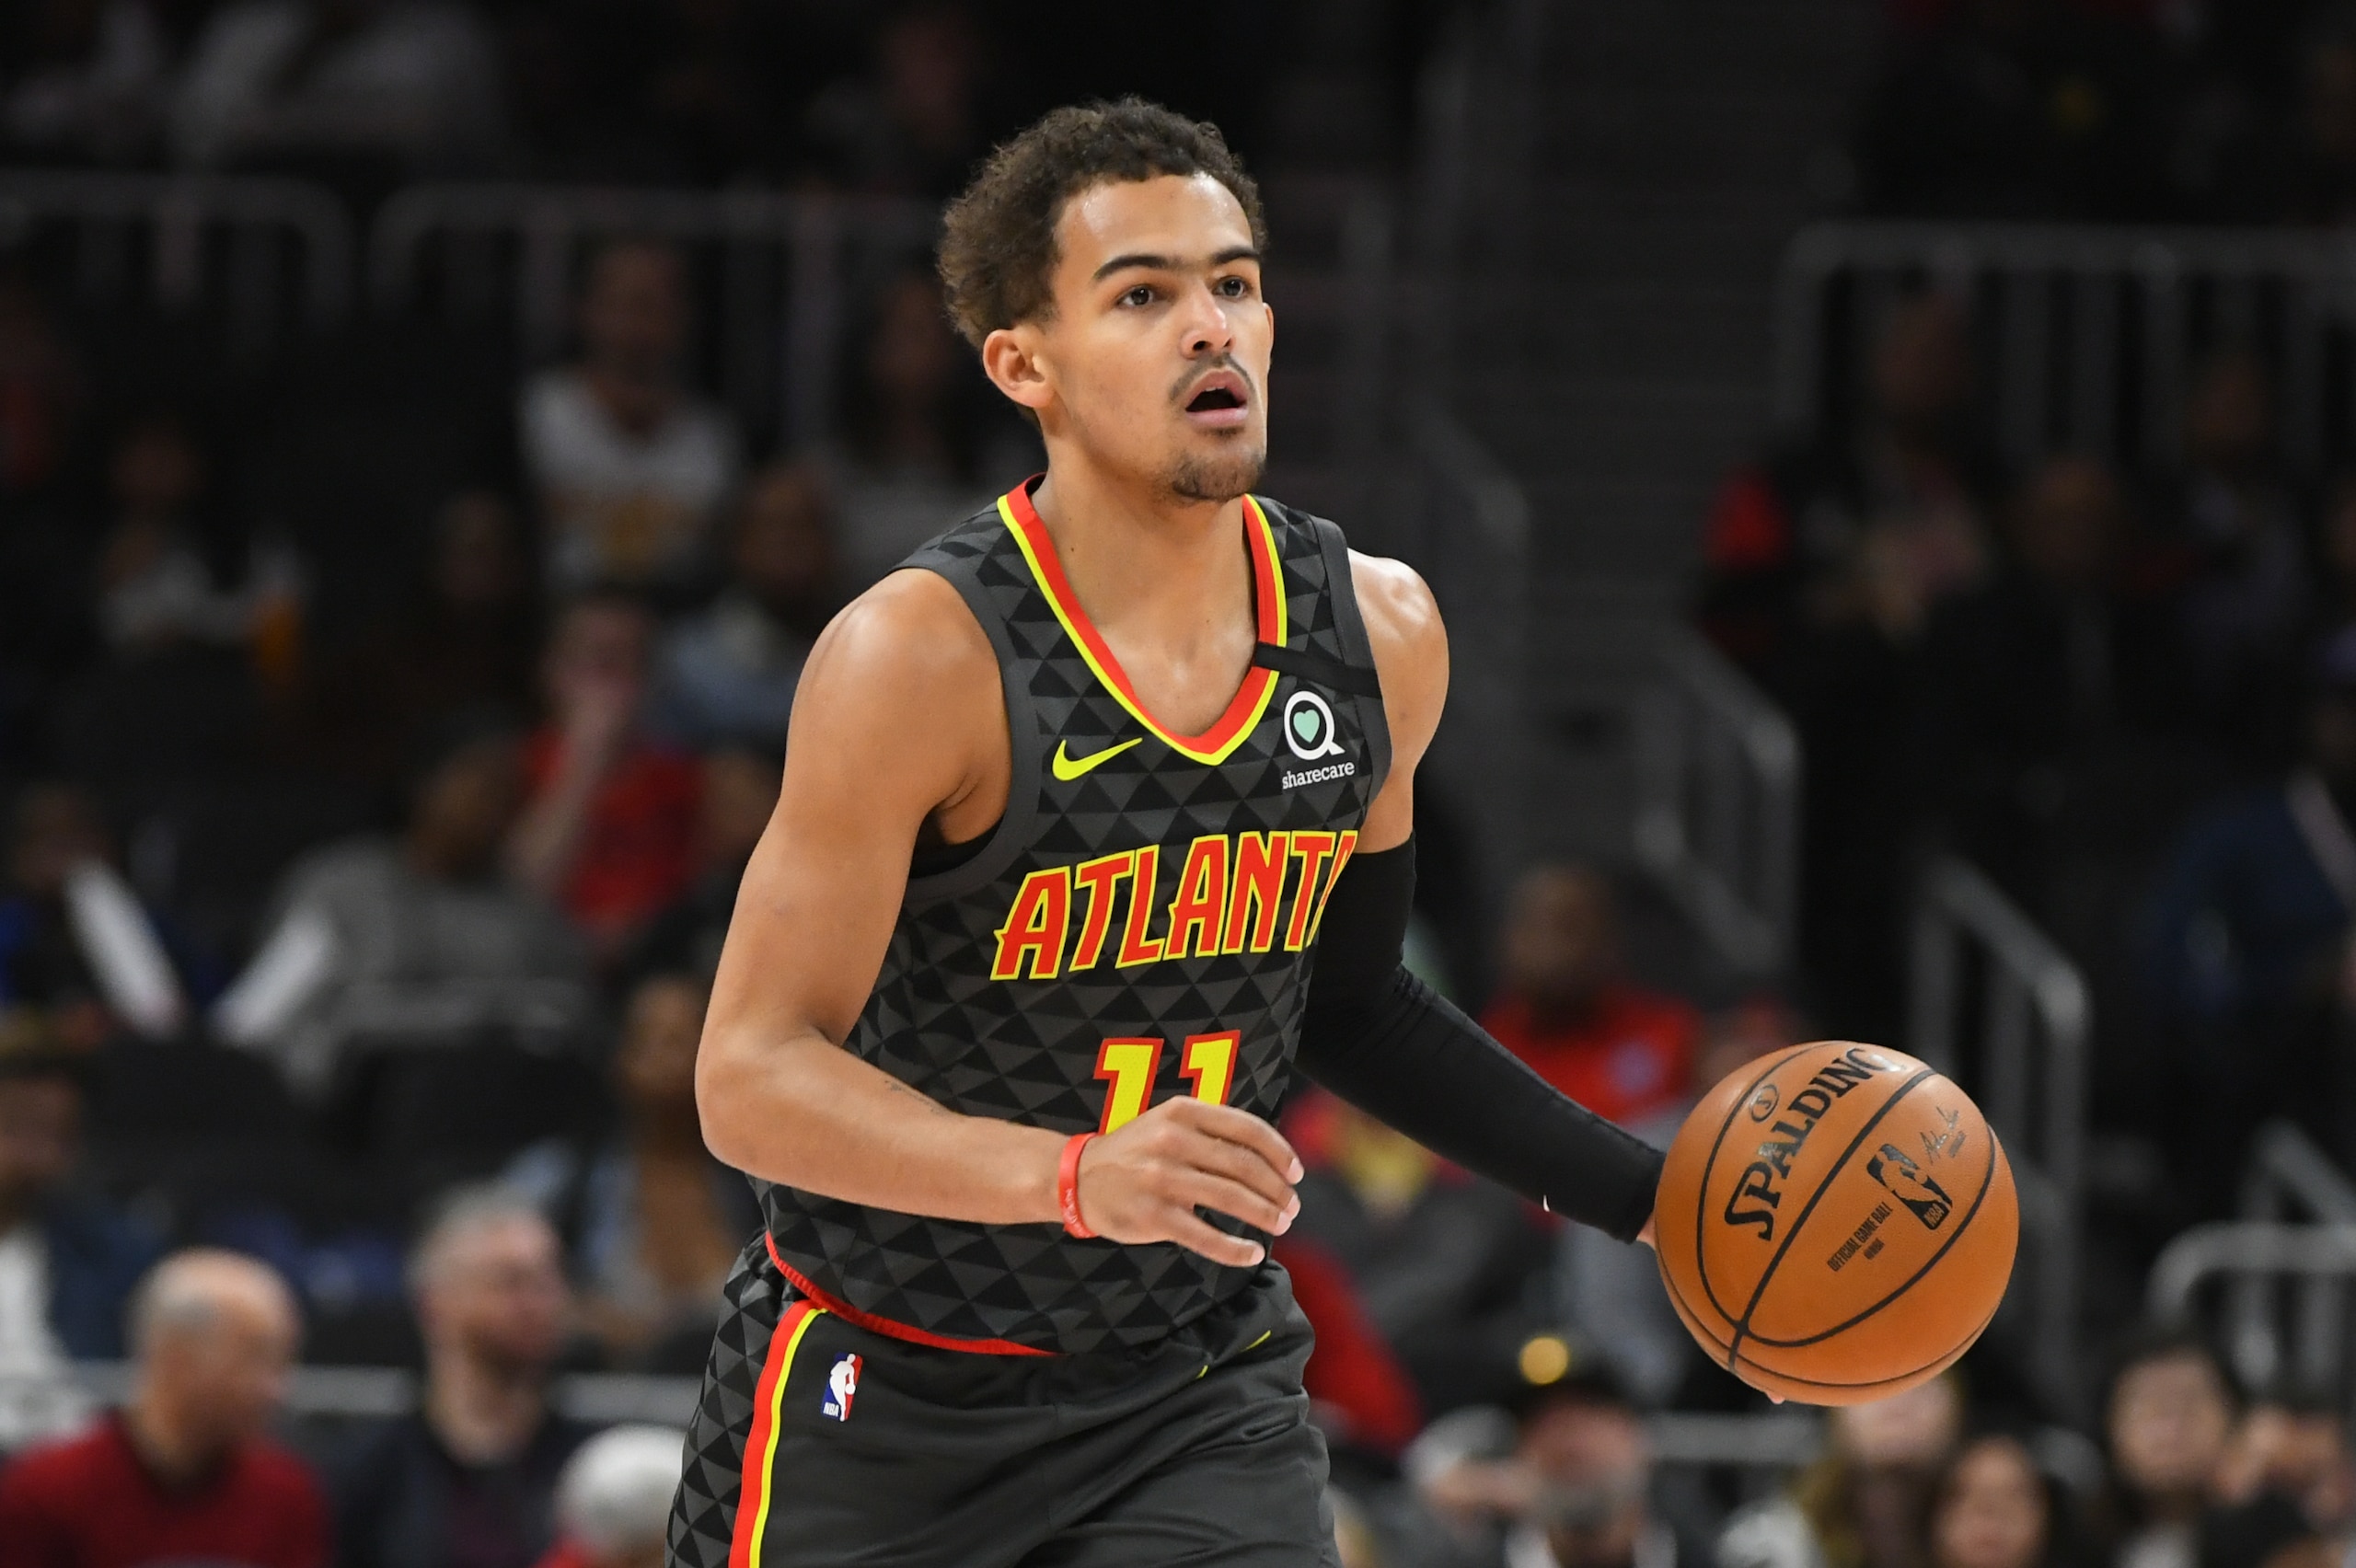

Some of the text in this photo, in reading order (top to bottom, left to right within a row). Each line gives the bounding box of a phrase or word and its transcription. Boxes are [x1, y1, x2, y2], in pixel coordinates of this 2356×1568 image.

[1282, 762, 1355, 790] sharecare
[1093, 1030, 1242, 1136] 11
[1923, 1202, 1945, 1228] NBA
[1827, 1200, 1893, 1272] OFFICIAL GAME BALL
[823, 1401, 839, 1417] NBA
